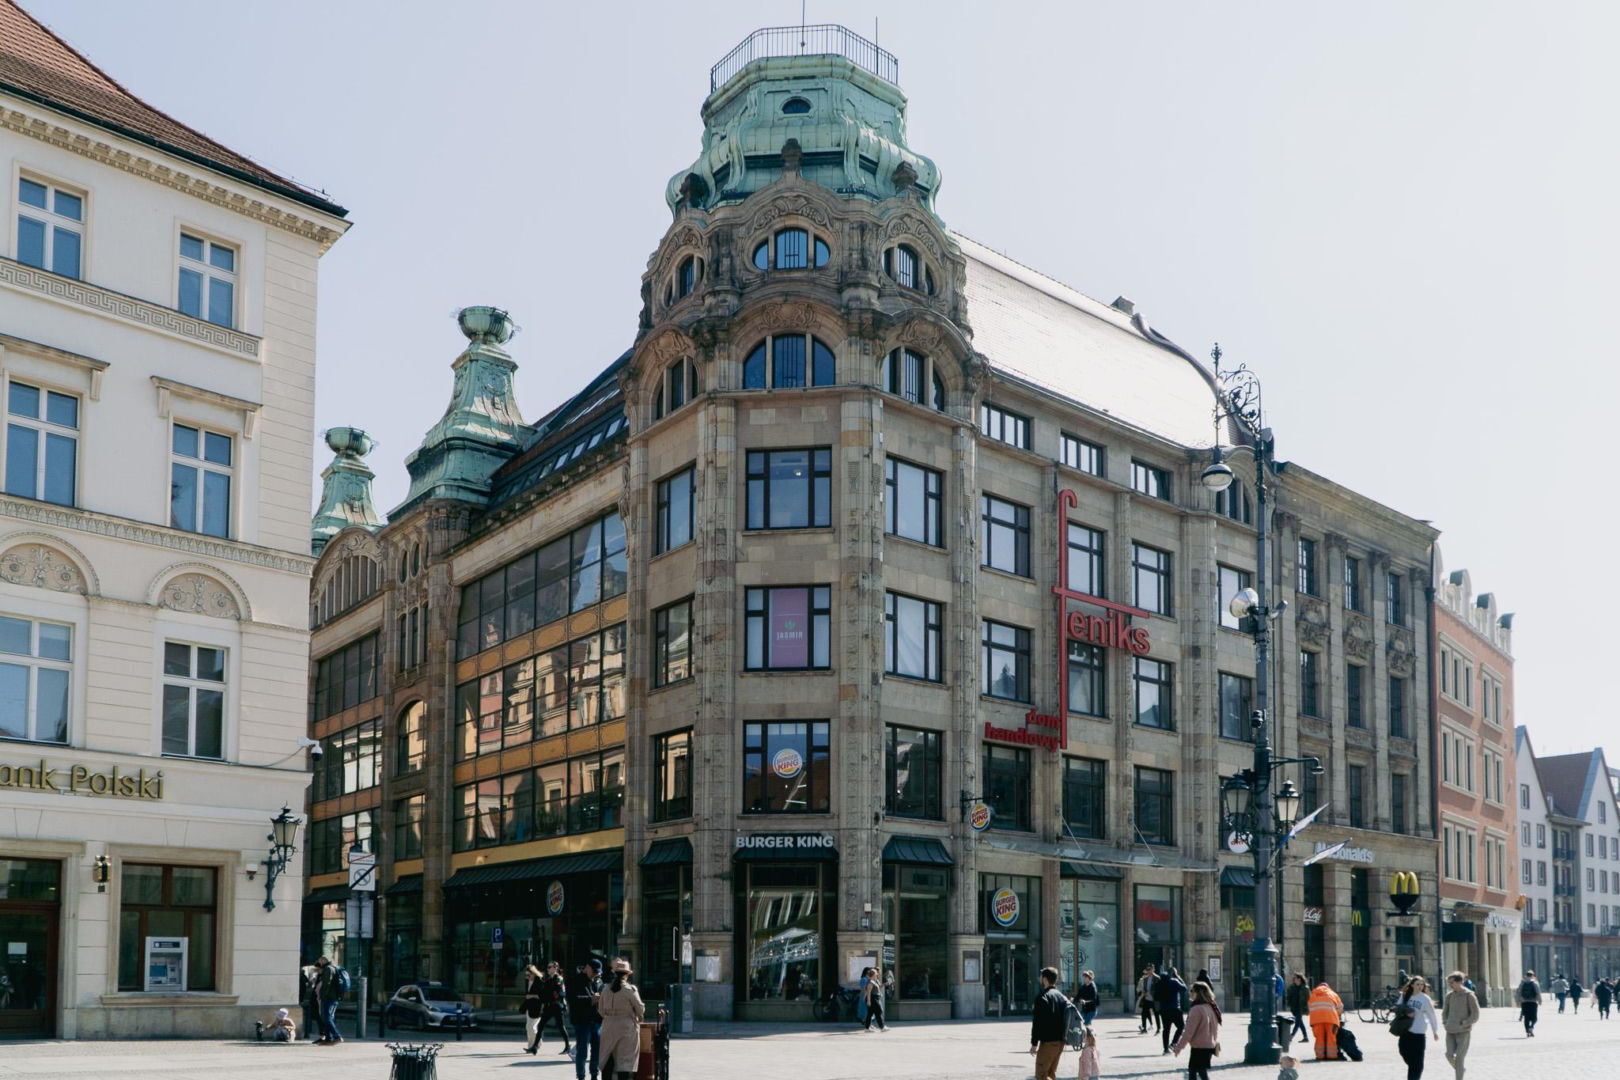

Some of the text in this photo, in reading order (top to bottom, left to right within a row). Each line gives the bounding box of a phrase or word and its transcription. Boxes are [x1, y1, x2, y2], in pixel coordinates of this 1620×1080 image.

[1025, 708, 1061, 729] dom
[985, 721, 1059, 753] handlowy
[777, 760, 799, 771] KING
[70, 764, 164, 799] Polski
[736, 836, 834, 848] BURGER KING
[996, 896, 1016, 906] BURGER
[997, 902, 1017, 916] KING
